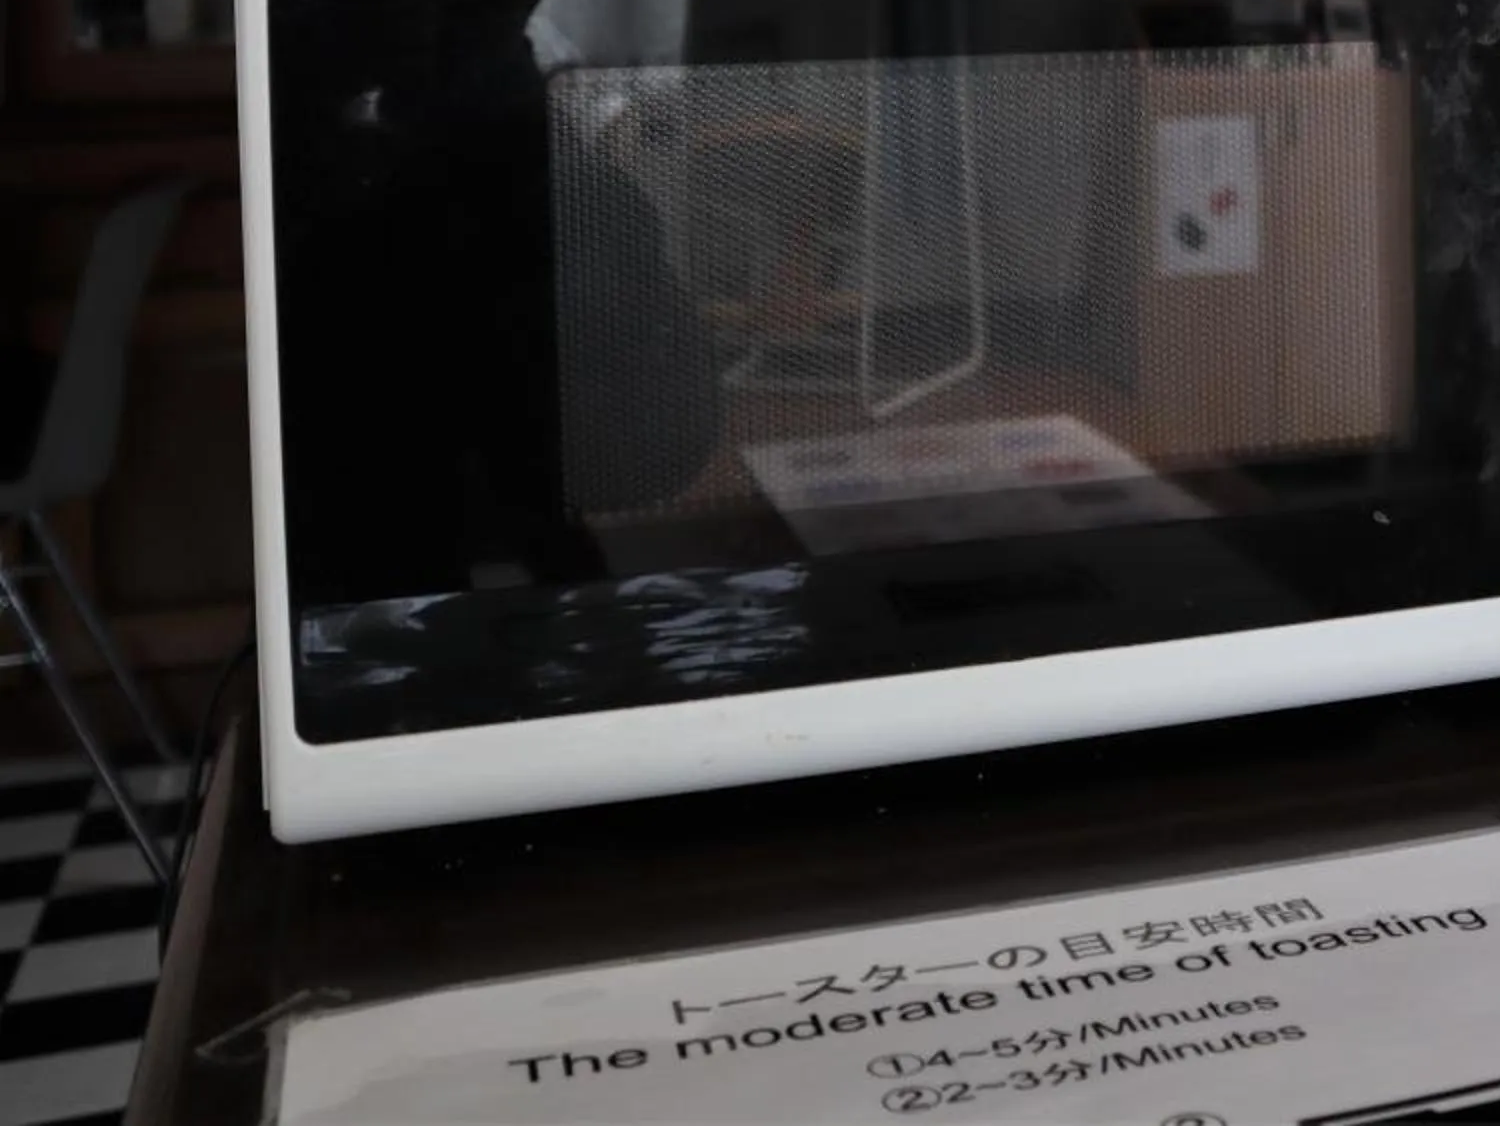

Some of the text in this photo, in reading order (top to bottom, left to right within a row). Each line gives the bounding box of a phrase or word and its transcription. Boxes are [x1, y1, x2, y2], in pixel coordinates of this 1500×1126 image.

[508, 905, 1489, 1083] The moderate time of toasting
[671, 897, 1326, 1024] トースターの目安時間
